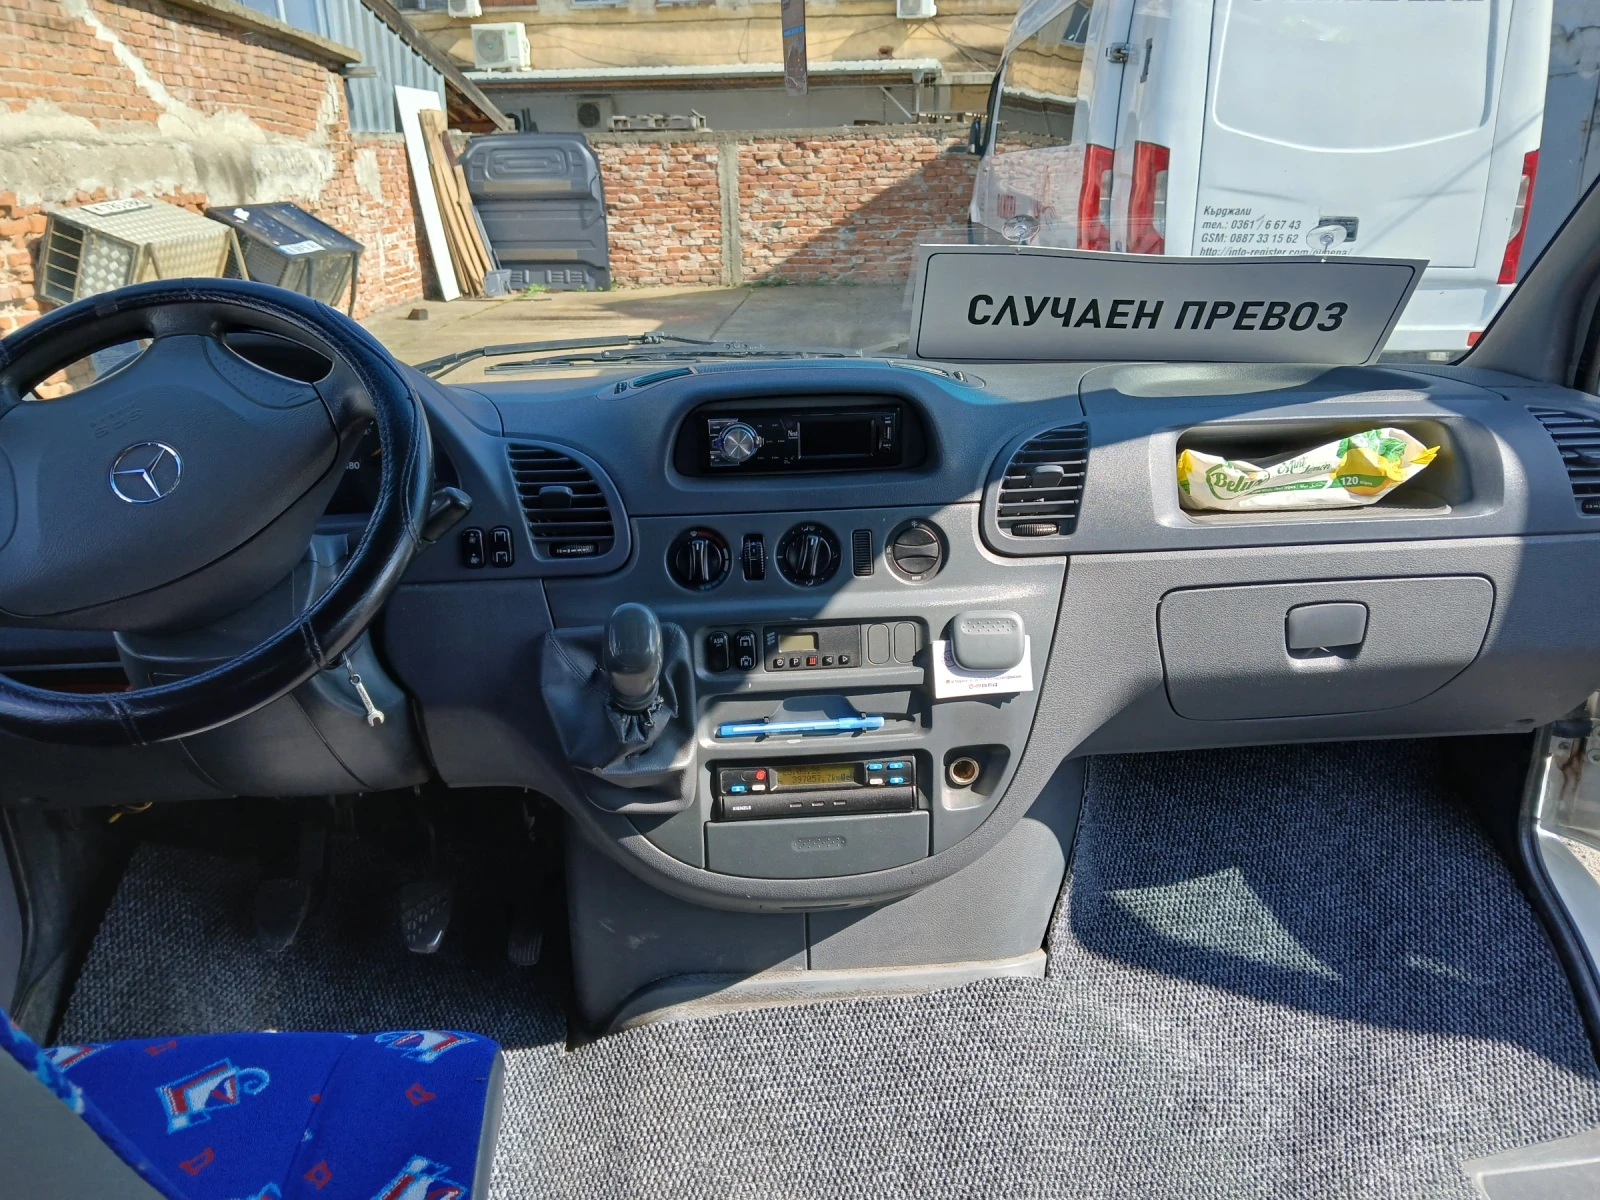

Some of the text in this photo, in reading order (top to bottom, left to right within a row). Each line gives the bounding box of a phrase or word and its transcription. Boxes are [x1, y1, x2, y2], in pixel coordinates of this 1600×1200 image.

[1203, 205, 1252, 217] Кърджали
[1202, 220, 1228, 230] тел.:
[1231, 219, 1255, 230] 0361
[1265, 220, 1271, 230] 6
[1274, 220, 1285, 230] 67
[1288, 220, 1301, 230] 43
[1201, 233, 1299, 243] GSM: 0887 33 15 62
[966, 294, 1350, 332] СЛУЧАЕН ПРЕВОЗ
[1340, 475, 1359, 486] 120
